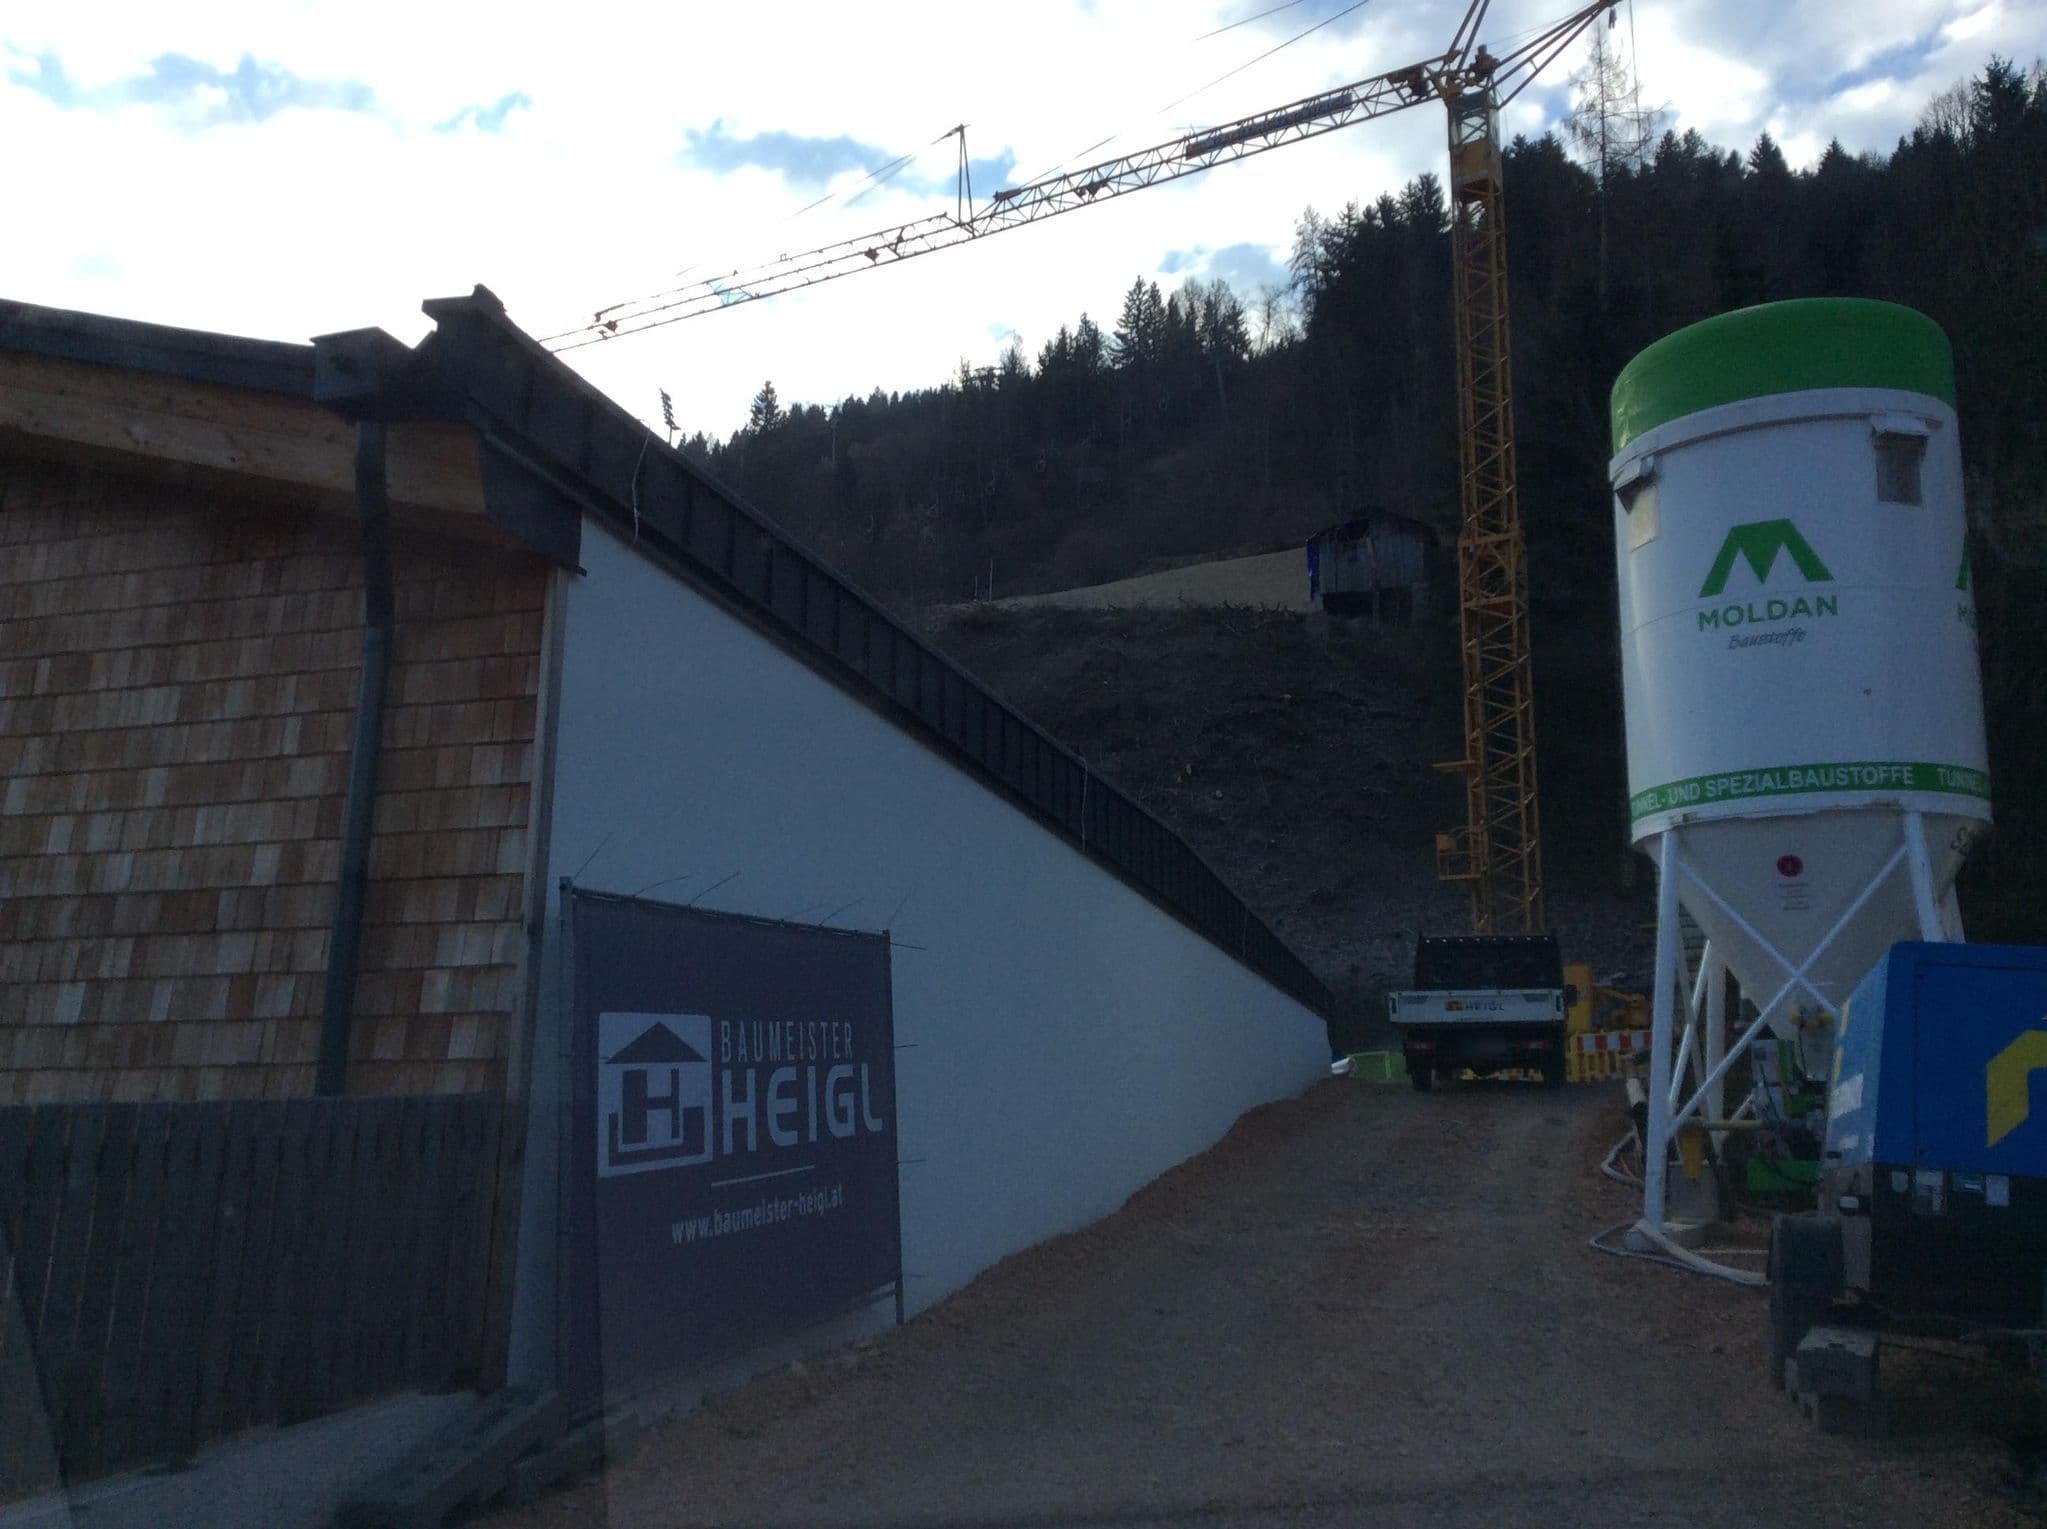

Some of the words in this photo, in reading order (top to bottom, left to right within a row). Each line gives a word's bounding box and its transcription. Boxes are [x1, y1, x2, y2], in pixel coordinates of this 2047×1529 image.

[1698, 595, 1839, 632] MOLDAN
[1668, 783, 1700, 804] UND
[1705, 767, 1915, 798] SPEZIALBAUSTOFFE
[720, 1019, 853, 1063] BAUMEISTER
[721, 1063, 883, 1155] HEIGL
[671, 1184, 843, 1244] www.baumeister-heigl.at
